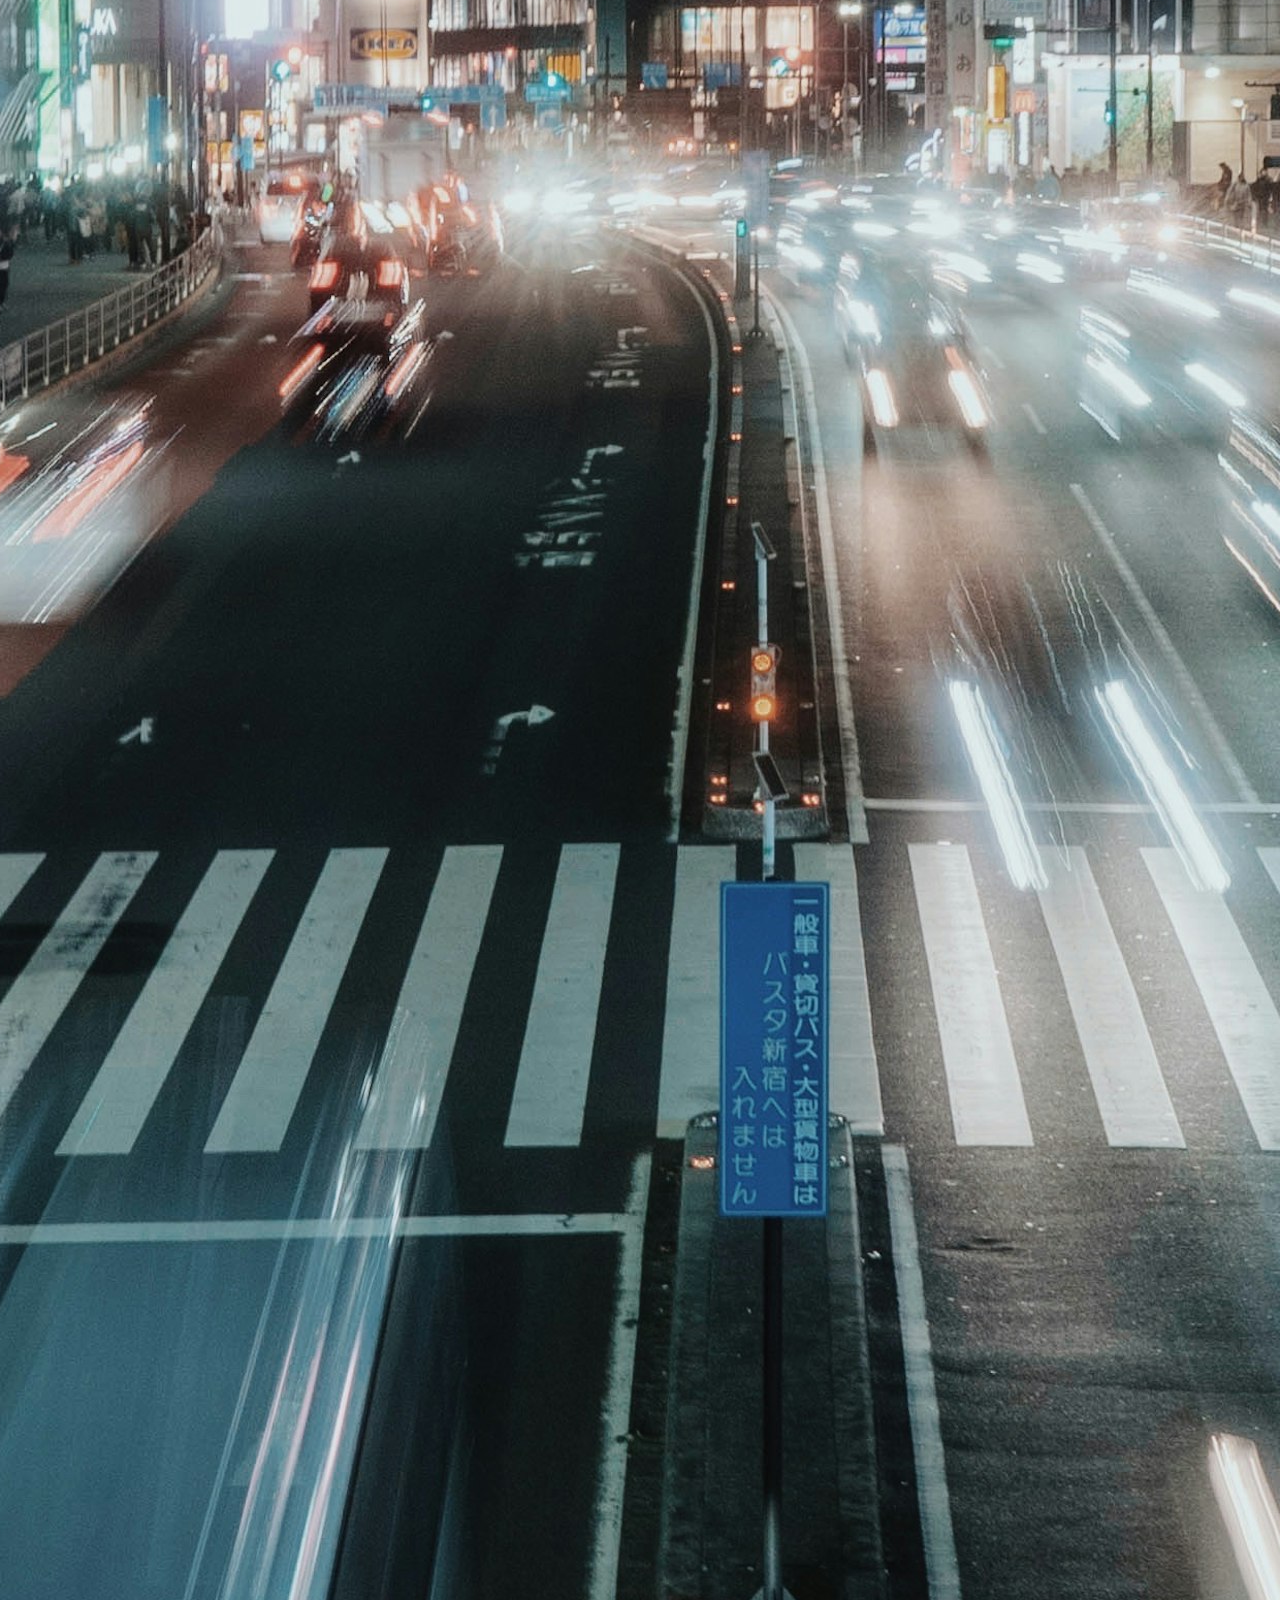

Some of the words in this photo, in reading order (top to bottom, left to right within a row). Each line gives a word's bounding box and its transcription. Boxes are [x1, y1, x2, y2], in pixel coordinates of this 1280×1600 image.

[356, 36, 416, 51] IKEA
[762, 951, 789, 1149] バスタ新宿へは
[793, 896, 820, 1206] 一般車・貸切バス・大型貨物車は
[730, 1066, 758, 1206] 入れません
